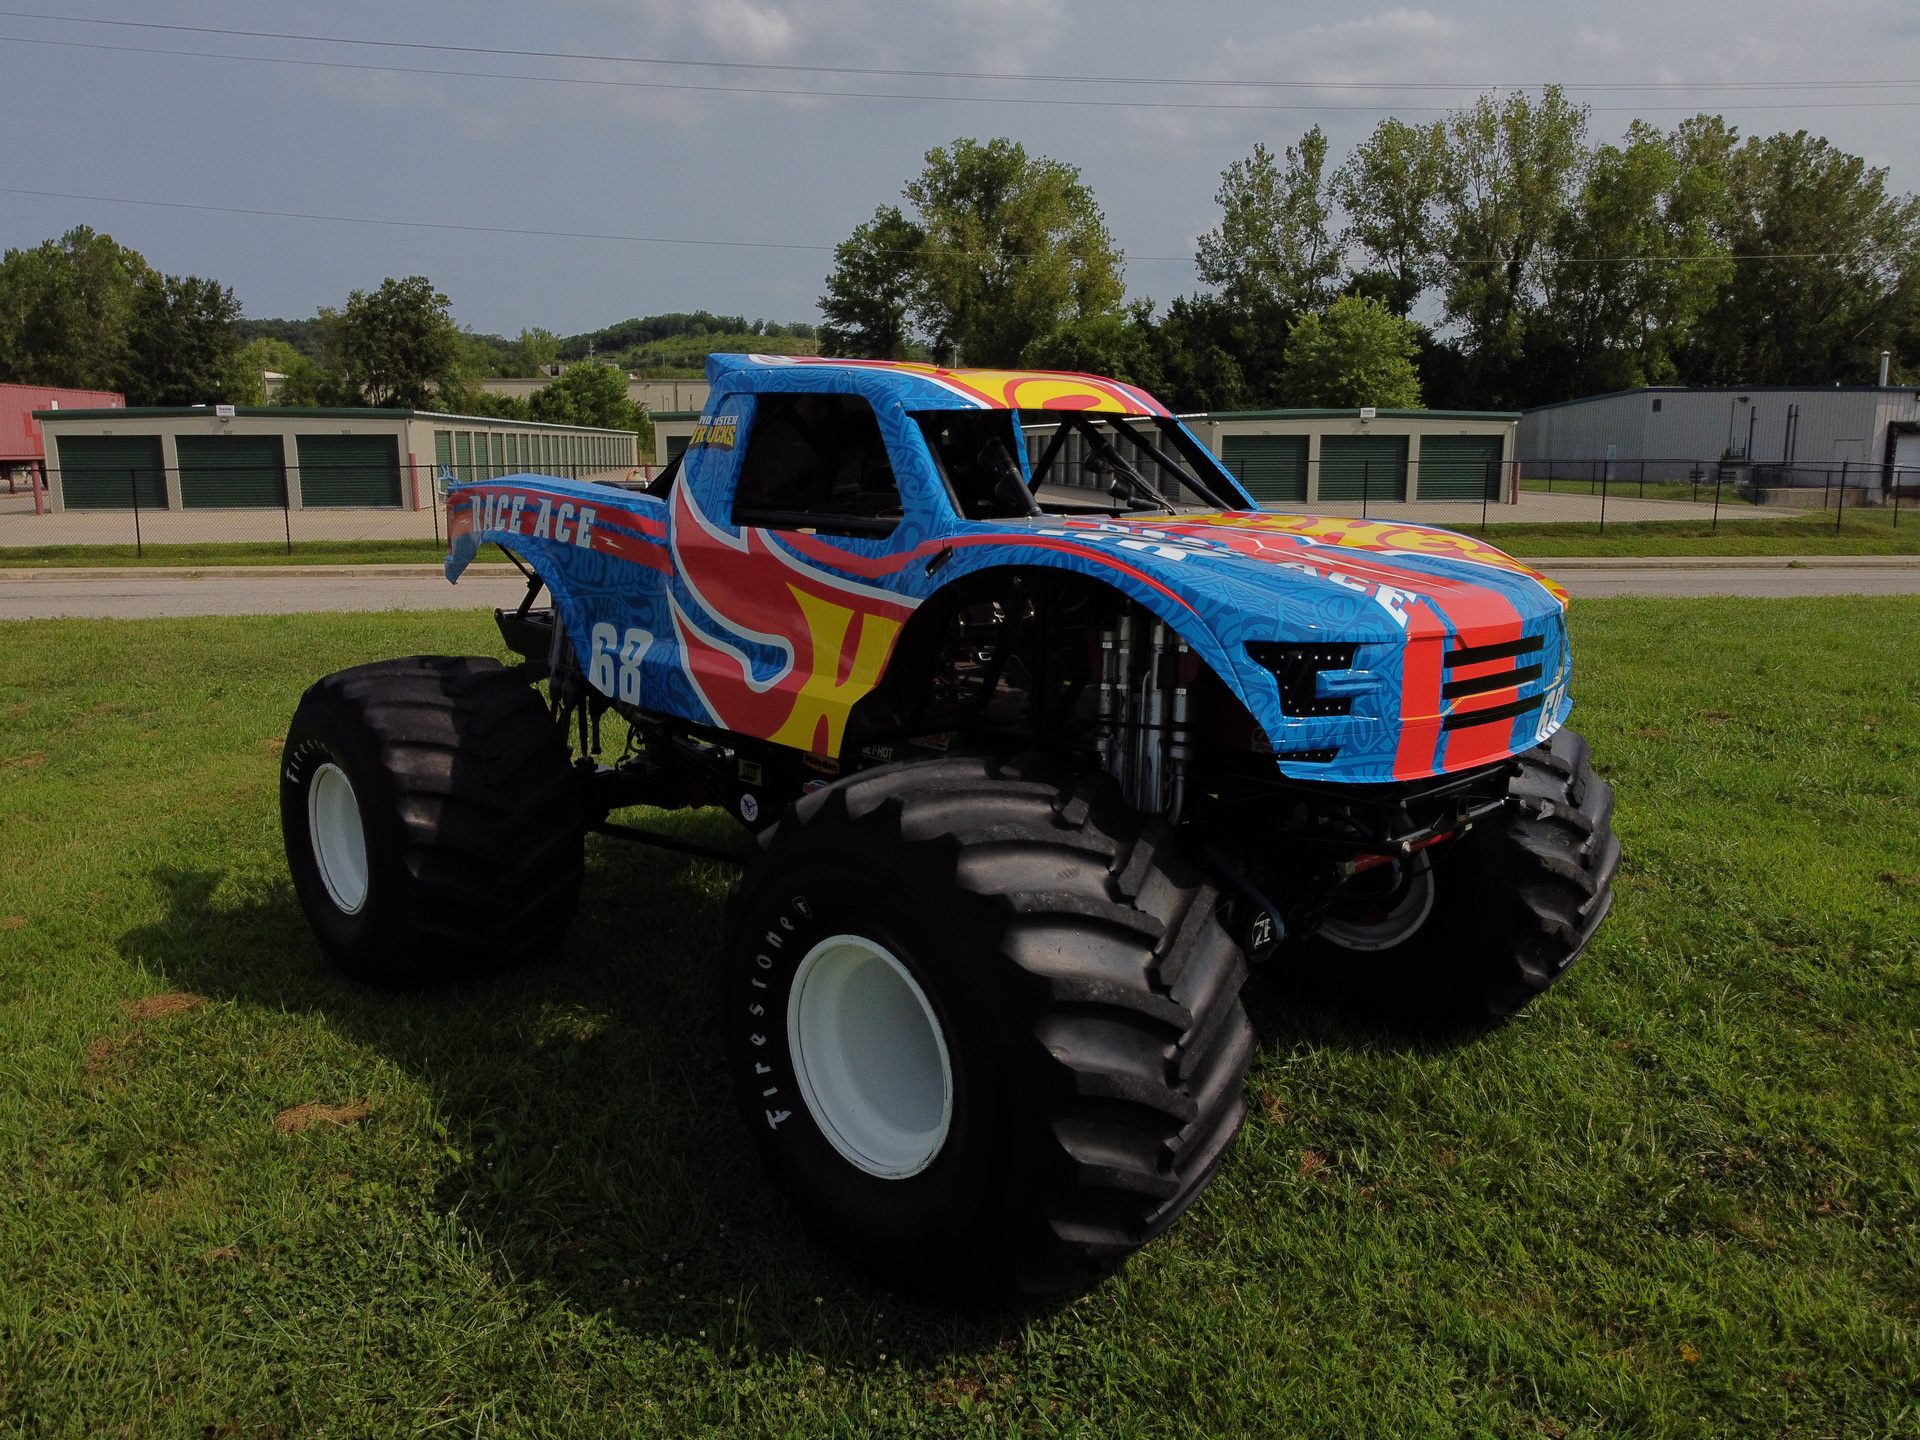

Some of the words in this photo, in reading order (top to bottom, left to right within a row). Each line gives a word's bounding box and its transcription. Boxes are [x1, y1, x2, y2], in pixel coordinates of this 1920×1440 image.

[689, 425, 737, 447] TRUCKS
[698, 415, 740, 426] MONSTER
[469, 494, 527, 534] RACE
[532, 498, 597, 549] ACE
[1275, 561, 1417, 629] ACE
[588, 622, 655, 706] 68
[805, 754, 839, 772] Milodon
[749, 915, 795, 1130] Firestone
